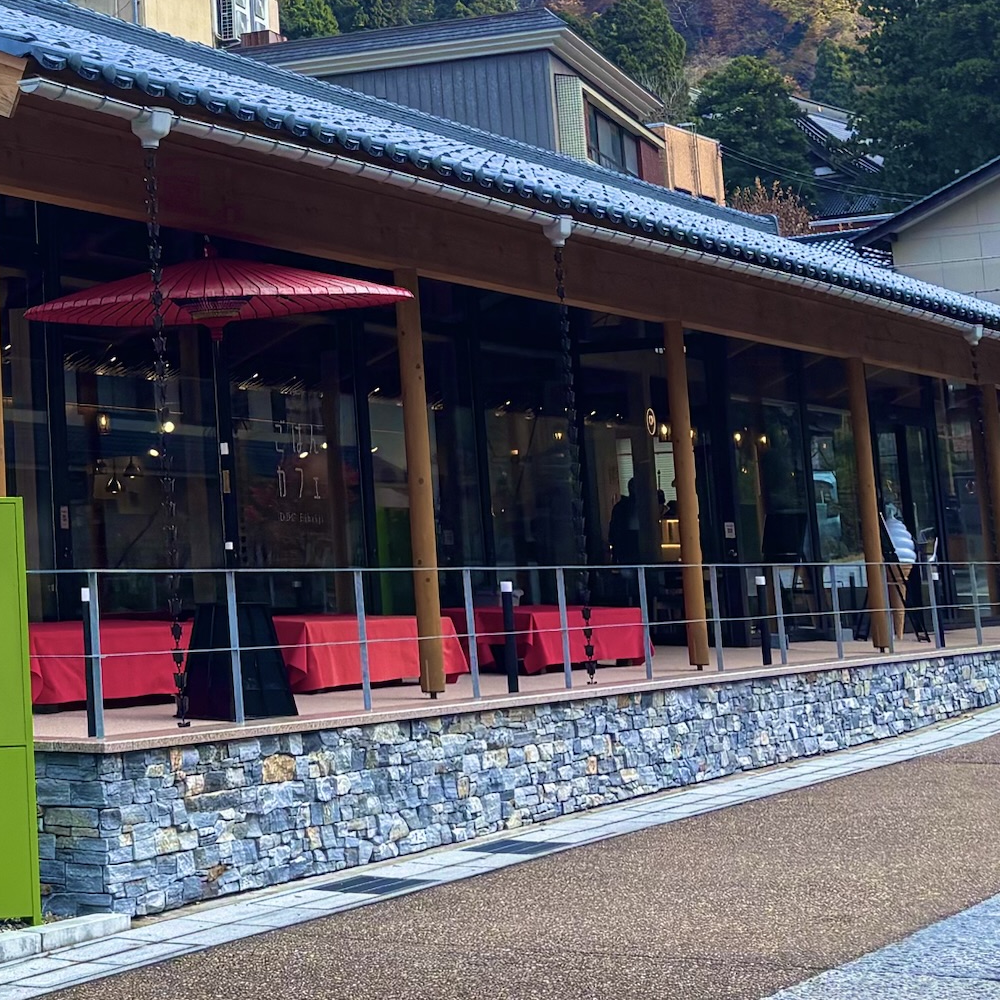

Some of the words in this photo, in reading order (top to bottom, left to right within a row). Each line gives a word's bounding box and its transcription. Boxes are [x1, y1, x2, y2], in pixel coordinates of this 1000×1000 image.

[275, 420, 319, 454] ごはん
[276, 465, 321, 499] カフェ
